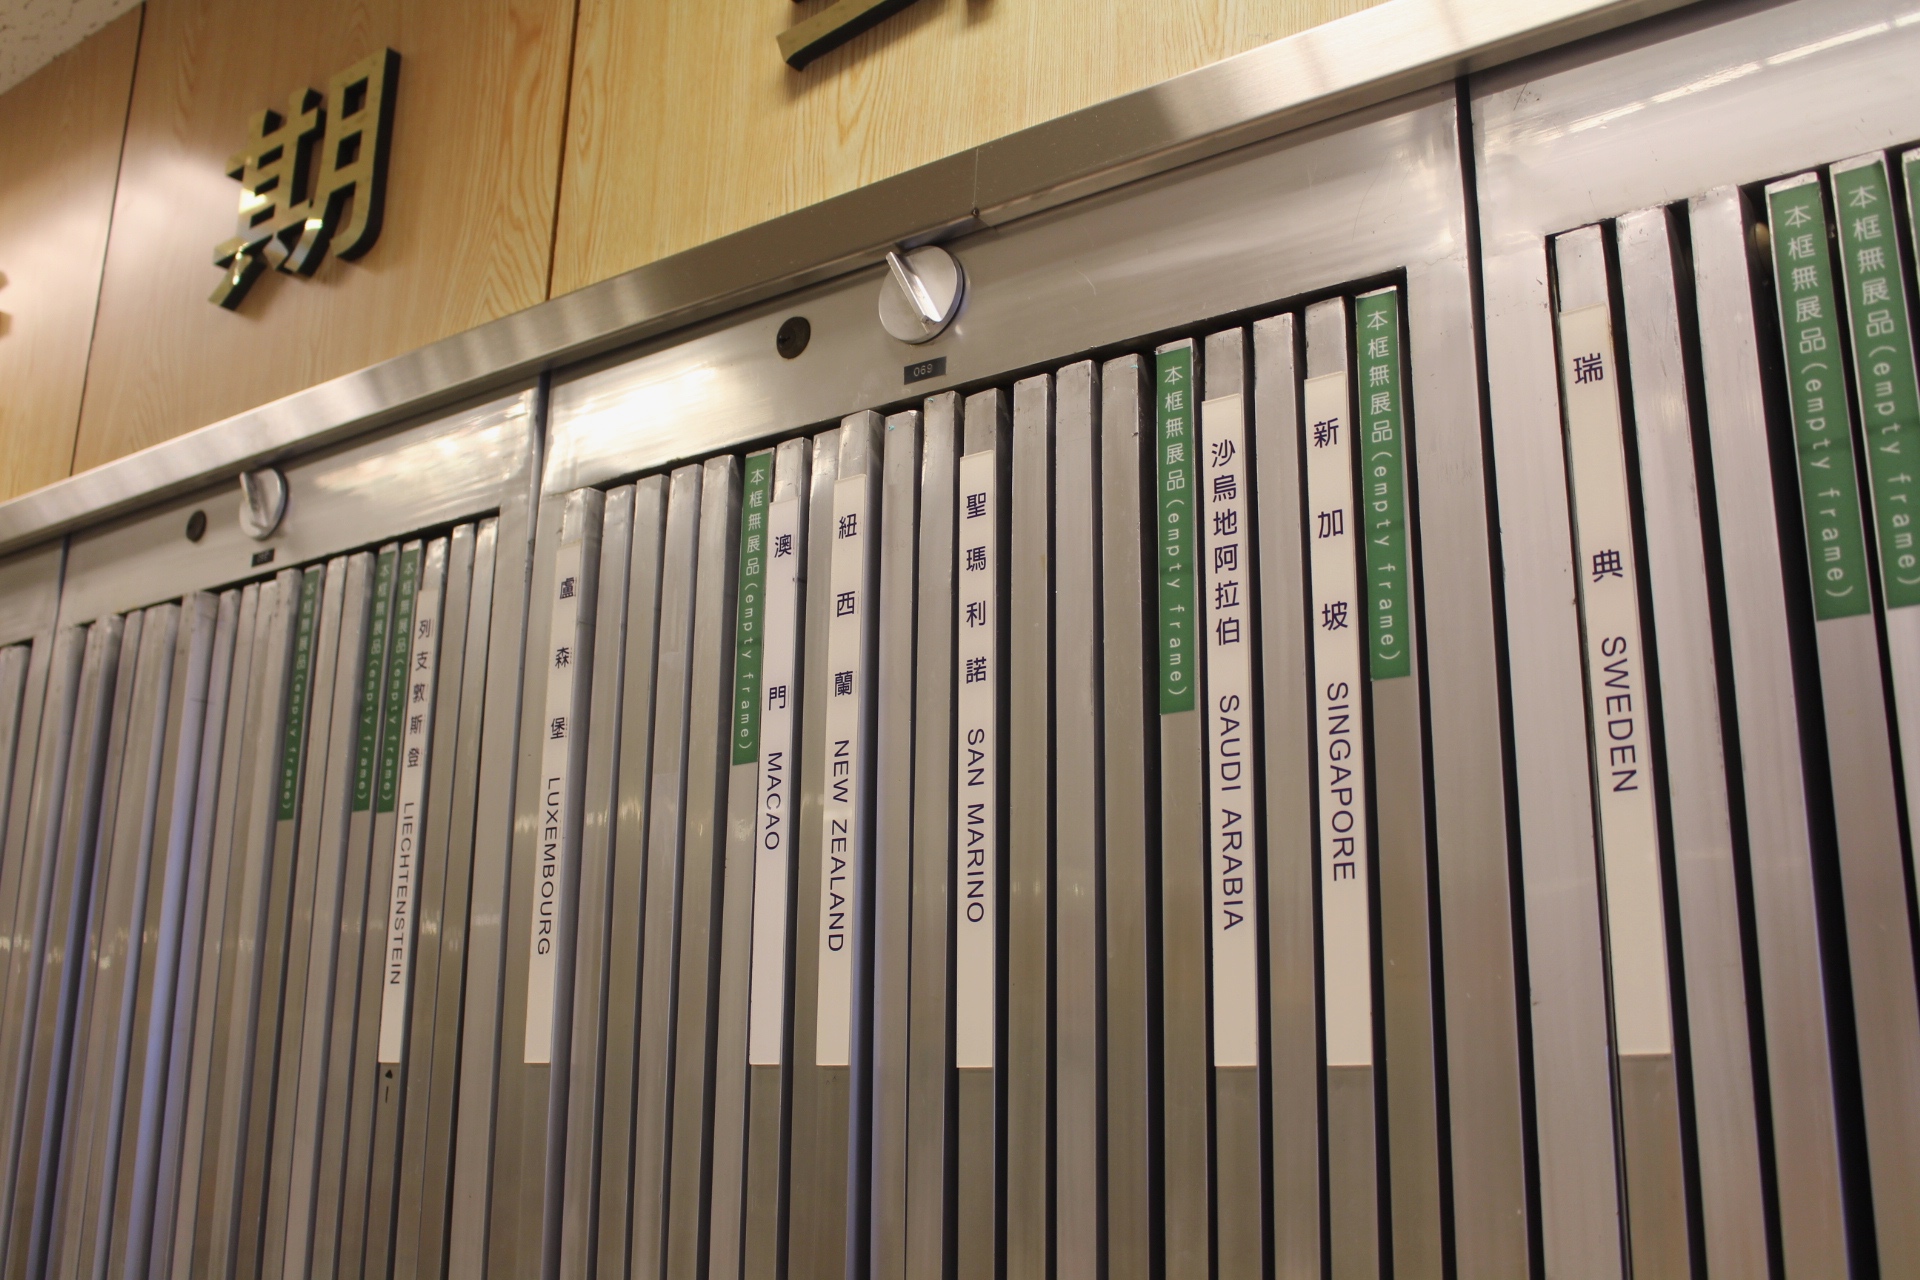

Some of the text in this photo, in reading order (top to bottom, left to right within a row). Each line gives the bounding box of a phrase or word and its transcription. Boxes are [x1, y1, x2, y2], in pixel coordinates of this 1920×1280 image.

[208, 47, 401, 311] 期
[1784, 205, 1826, 354] 本框無展品
[1849, 185, 1895, 338] 本框無展品
[913, 363, 933, 377] 069
[1164, 366, 1185, 491] 本框無展品
[1367, 310, 1393, 443] 本框無展品
[745, 468, 765, 576] 本框無展品
[966, 492, 987, 922] 聖瑪利諾 SAN MARINO
[1211, 439, 1243, 930] 沙烏地阿拉伯 SAUDI ARABIA
[1314, 418, 1355, 881] 新加坡 SINGAPORE
[1601, 636, 1638, 792] SWEDEN
[537, 577, 574, 955] 盧森堡 LUXEMBOURG
[764, 752, 783, 850] MACAO
[828, 513, 857, 951] 紐西蘭 NEW ZEALAND
[389, 802, 415, 985] LIECHTENSTEIN
